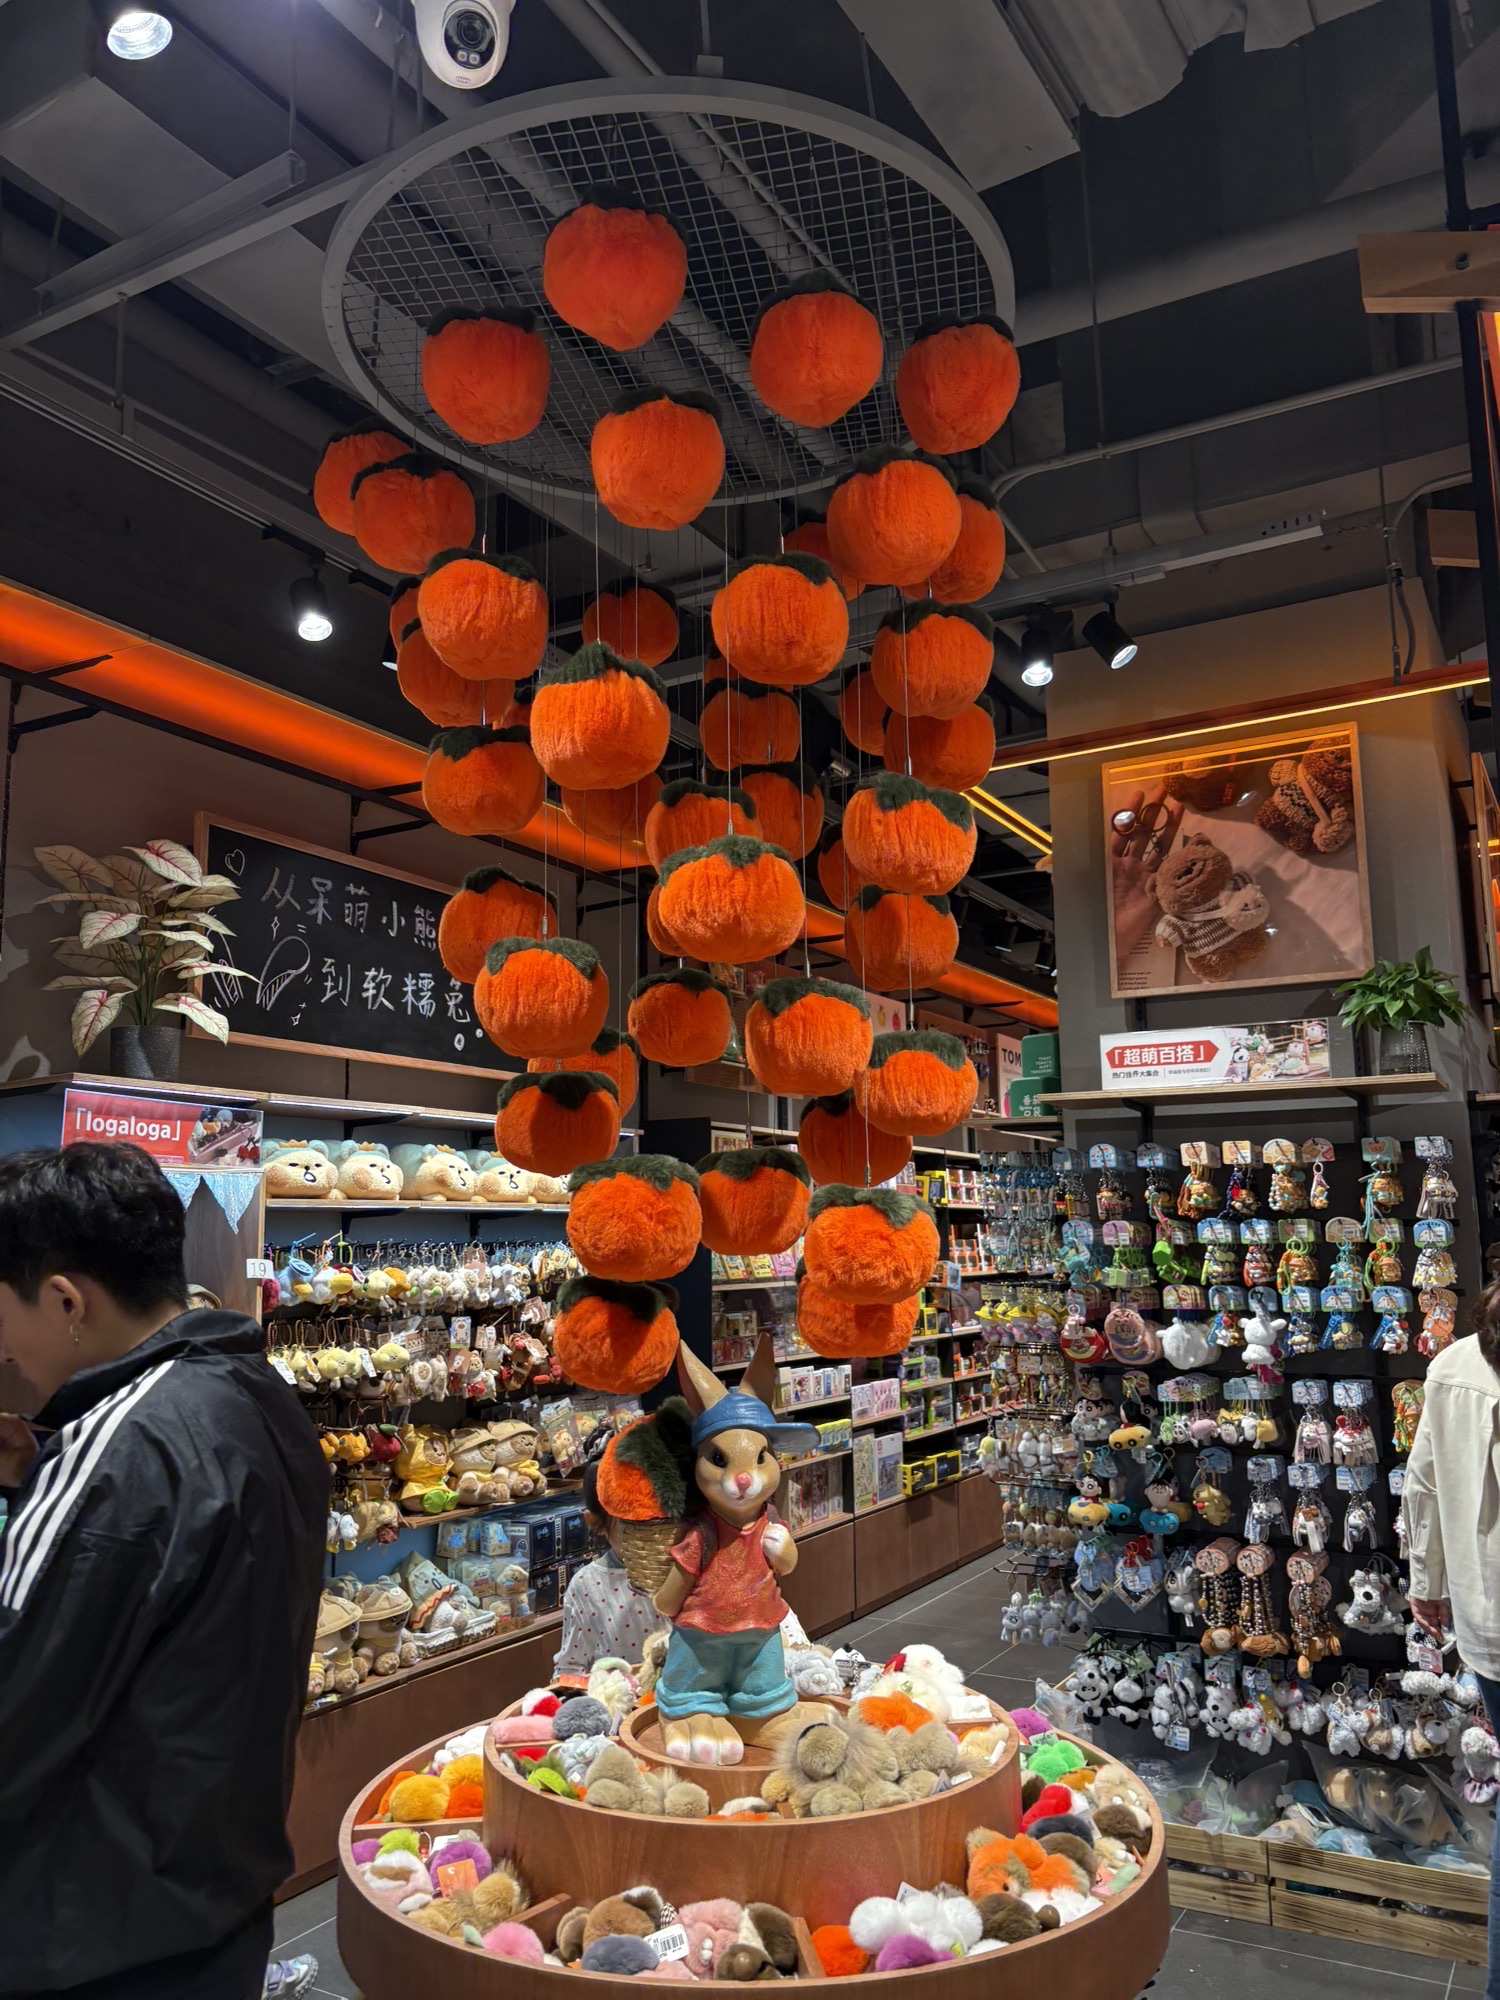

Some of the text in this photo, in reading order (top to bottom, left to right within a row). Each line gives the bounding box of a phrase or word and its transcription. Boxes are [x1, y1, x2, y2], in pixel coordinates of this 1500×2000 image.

[260, 867, 437, 952] 从呆萌小熊
[320, 958, 471, 1023] 到软糯兔
[1113, 1044, 1205, 1066] 「超萌百搭」
[250, 1262, 267, 1277] 19
